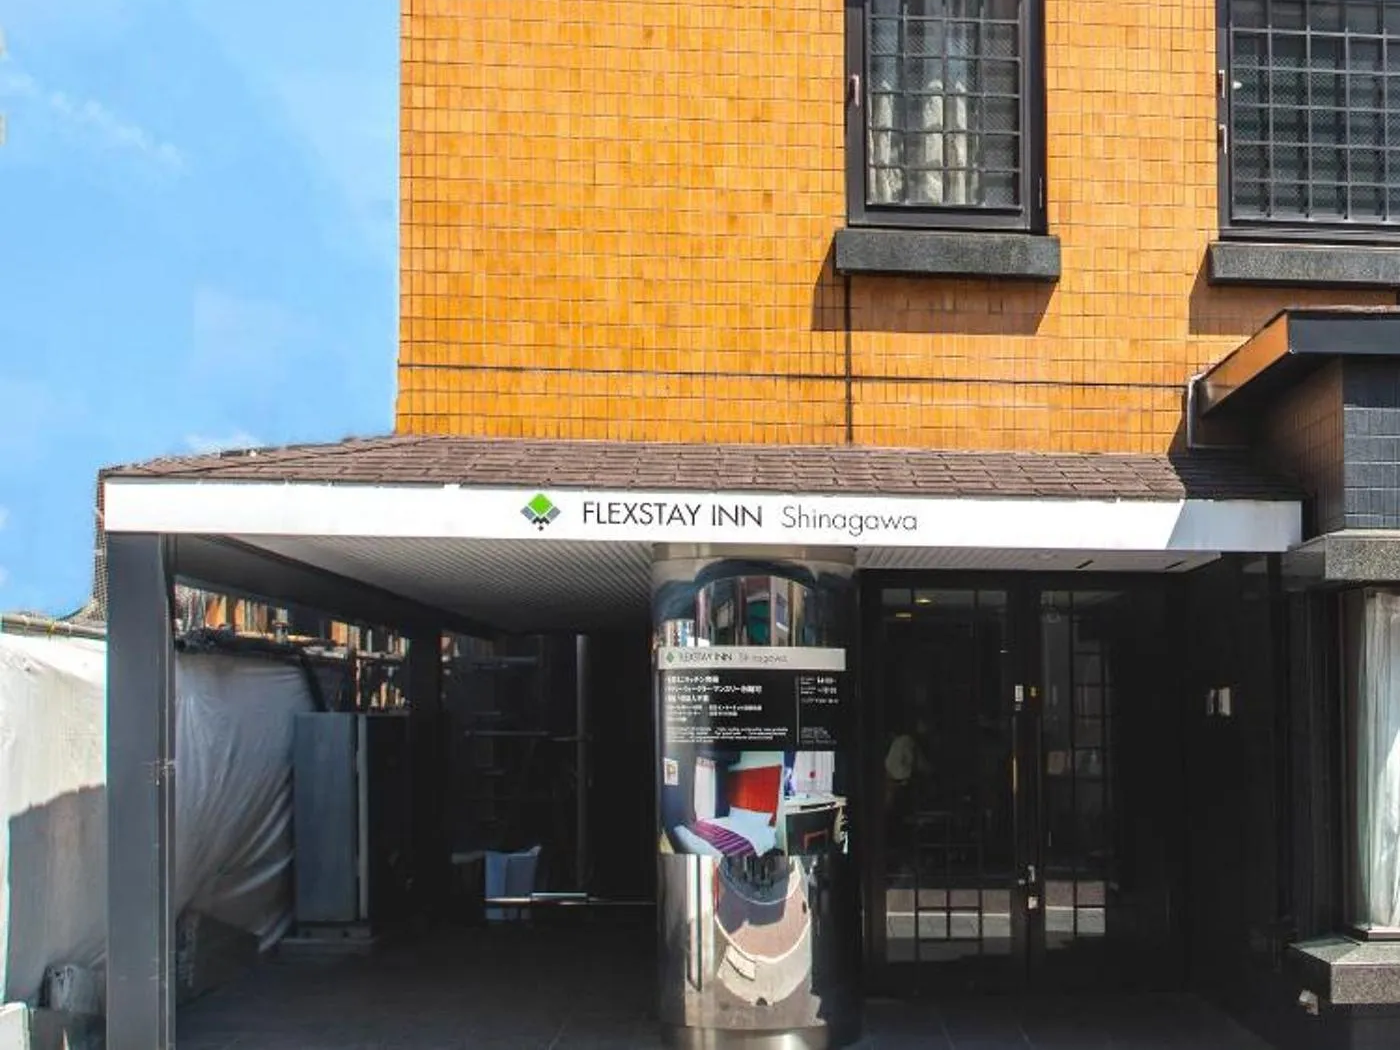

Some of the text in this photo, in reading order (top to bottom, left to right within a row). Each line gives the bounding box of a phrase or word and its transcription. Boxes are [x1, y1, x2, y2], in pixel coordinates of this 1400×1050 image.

[582, 502, 918, 537] FLEXSTAY INN Shinagawa
